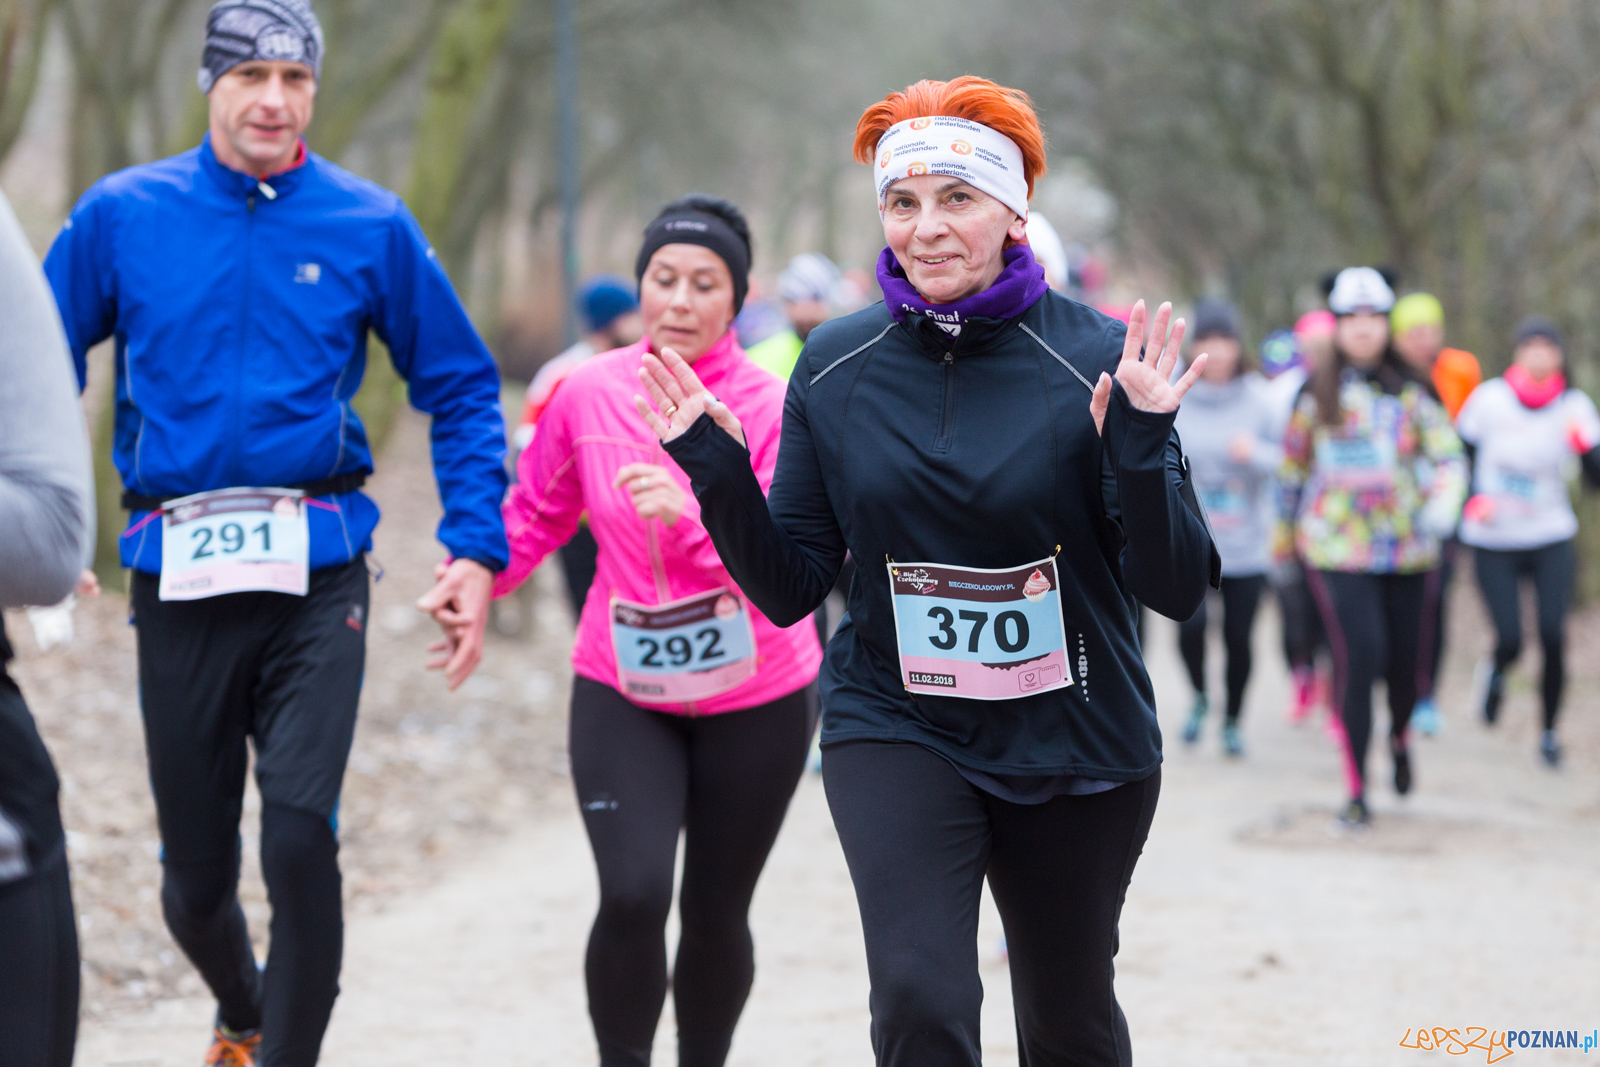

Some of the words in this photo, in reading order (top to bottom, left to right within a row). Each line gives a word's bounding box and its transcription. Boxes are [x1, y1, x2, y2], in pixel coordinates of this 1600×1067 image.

[935, 121, 981, 133] nederlanden
[893, 145, 938, 157] nederlanden
[894, 141, 926, 152] nationale
[975, 146, 1002, 161] nationale
[931, 162, 967, 171] nationale
[975, 152, 1009, 171] nederlanden
[931, 168, 976, 180] nederlanden
[191, 522, 270, 559] 291
[948, 580, 1016, 591] BIEGCZEKOLADOWY.PL
[927, 606, 1030, 653] 370
[636, 627, 725, 667] 292
[911, 673, 954, 686] 11.02.2018
